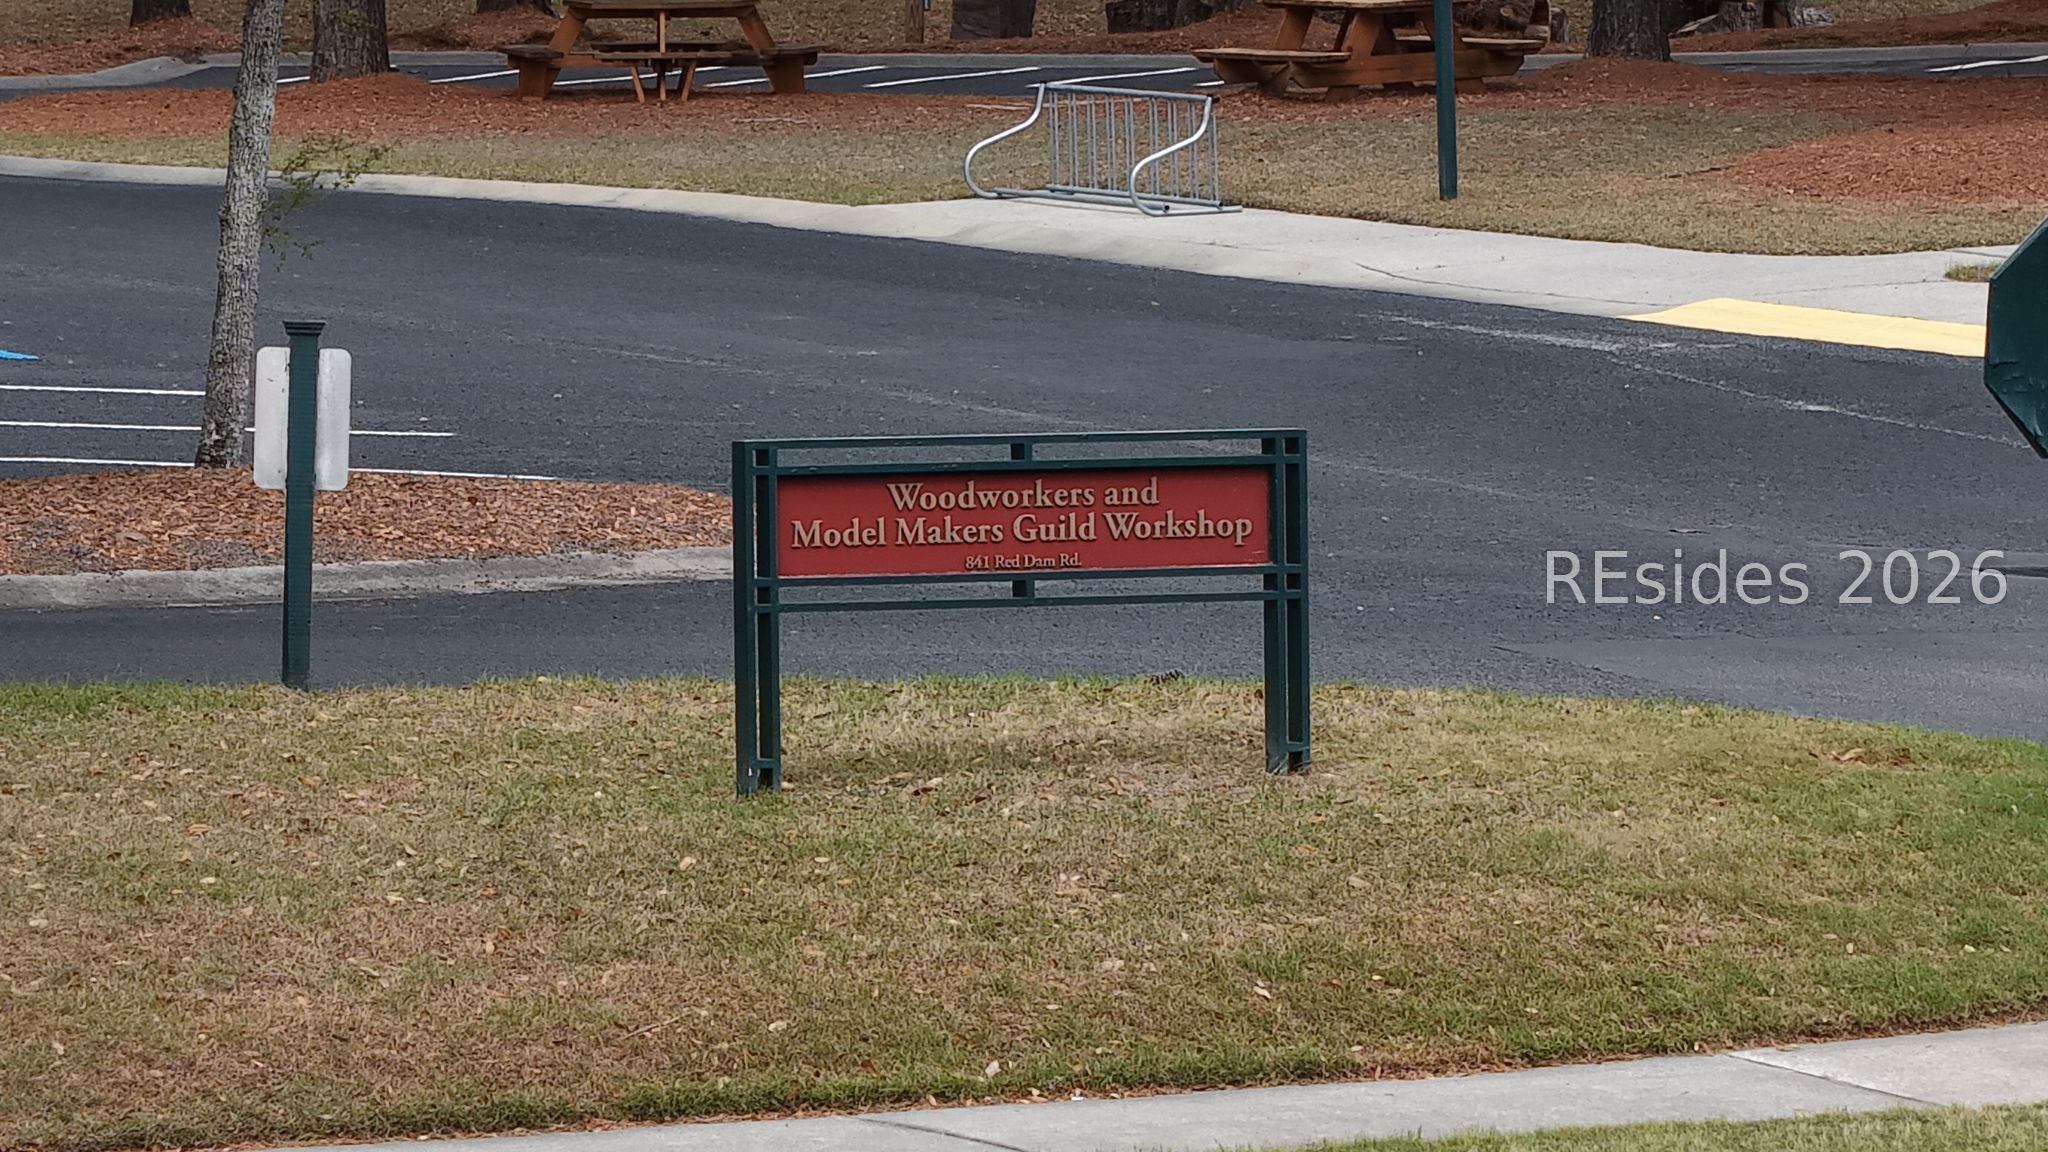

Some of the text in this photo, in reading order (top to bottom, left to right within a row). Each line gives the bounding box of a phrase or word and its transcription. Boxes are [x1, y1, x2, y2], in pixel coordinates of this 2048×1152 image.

[887, 476, 1160, 511] Woodworkers and
[791, 508, 1253, 548] Model Makers Guild Workshop
[965, 553, 1082, 569] 841 Red Dam Rd.
